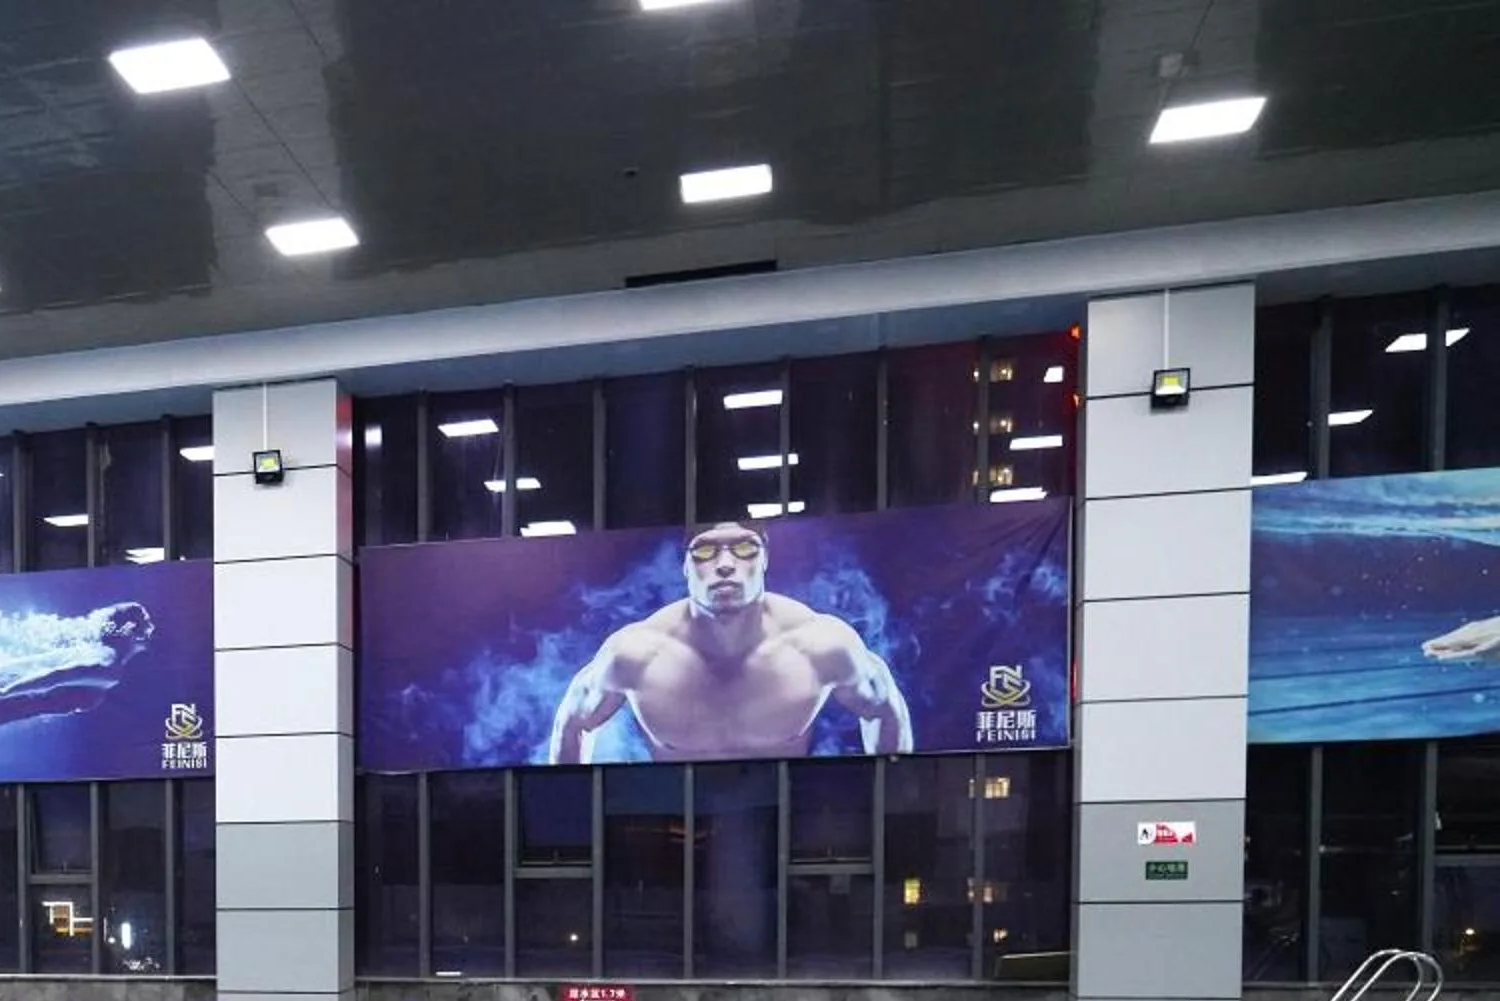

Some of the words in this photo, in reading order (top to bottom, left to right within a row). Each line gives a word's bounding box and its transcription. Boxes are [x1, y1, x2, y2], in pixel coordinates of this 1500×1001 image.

[976, 709, 1037, 729] 菲尼斯
[161, 741, 207, 759] 菲尼斯
